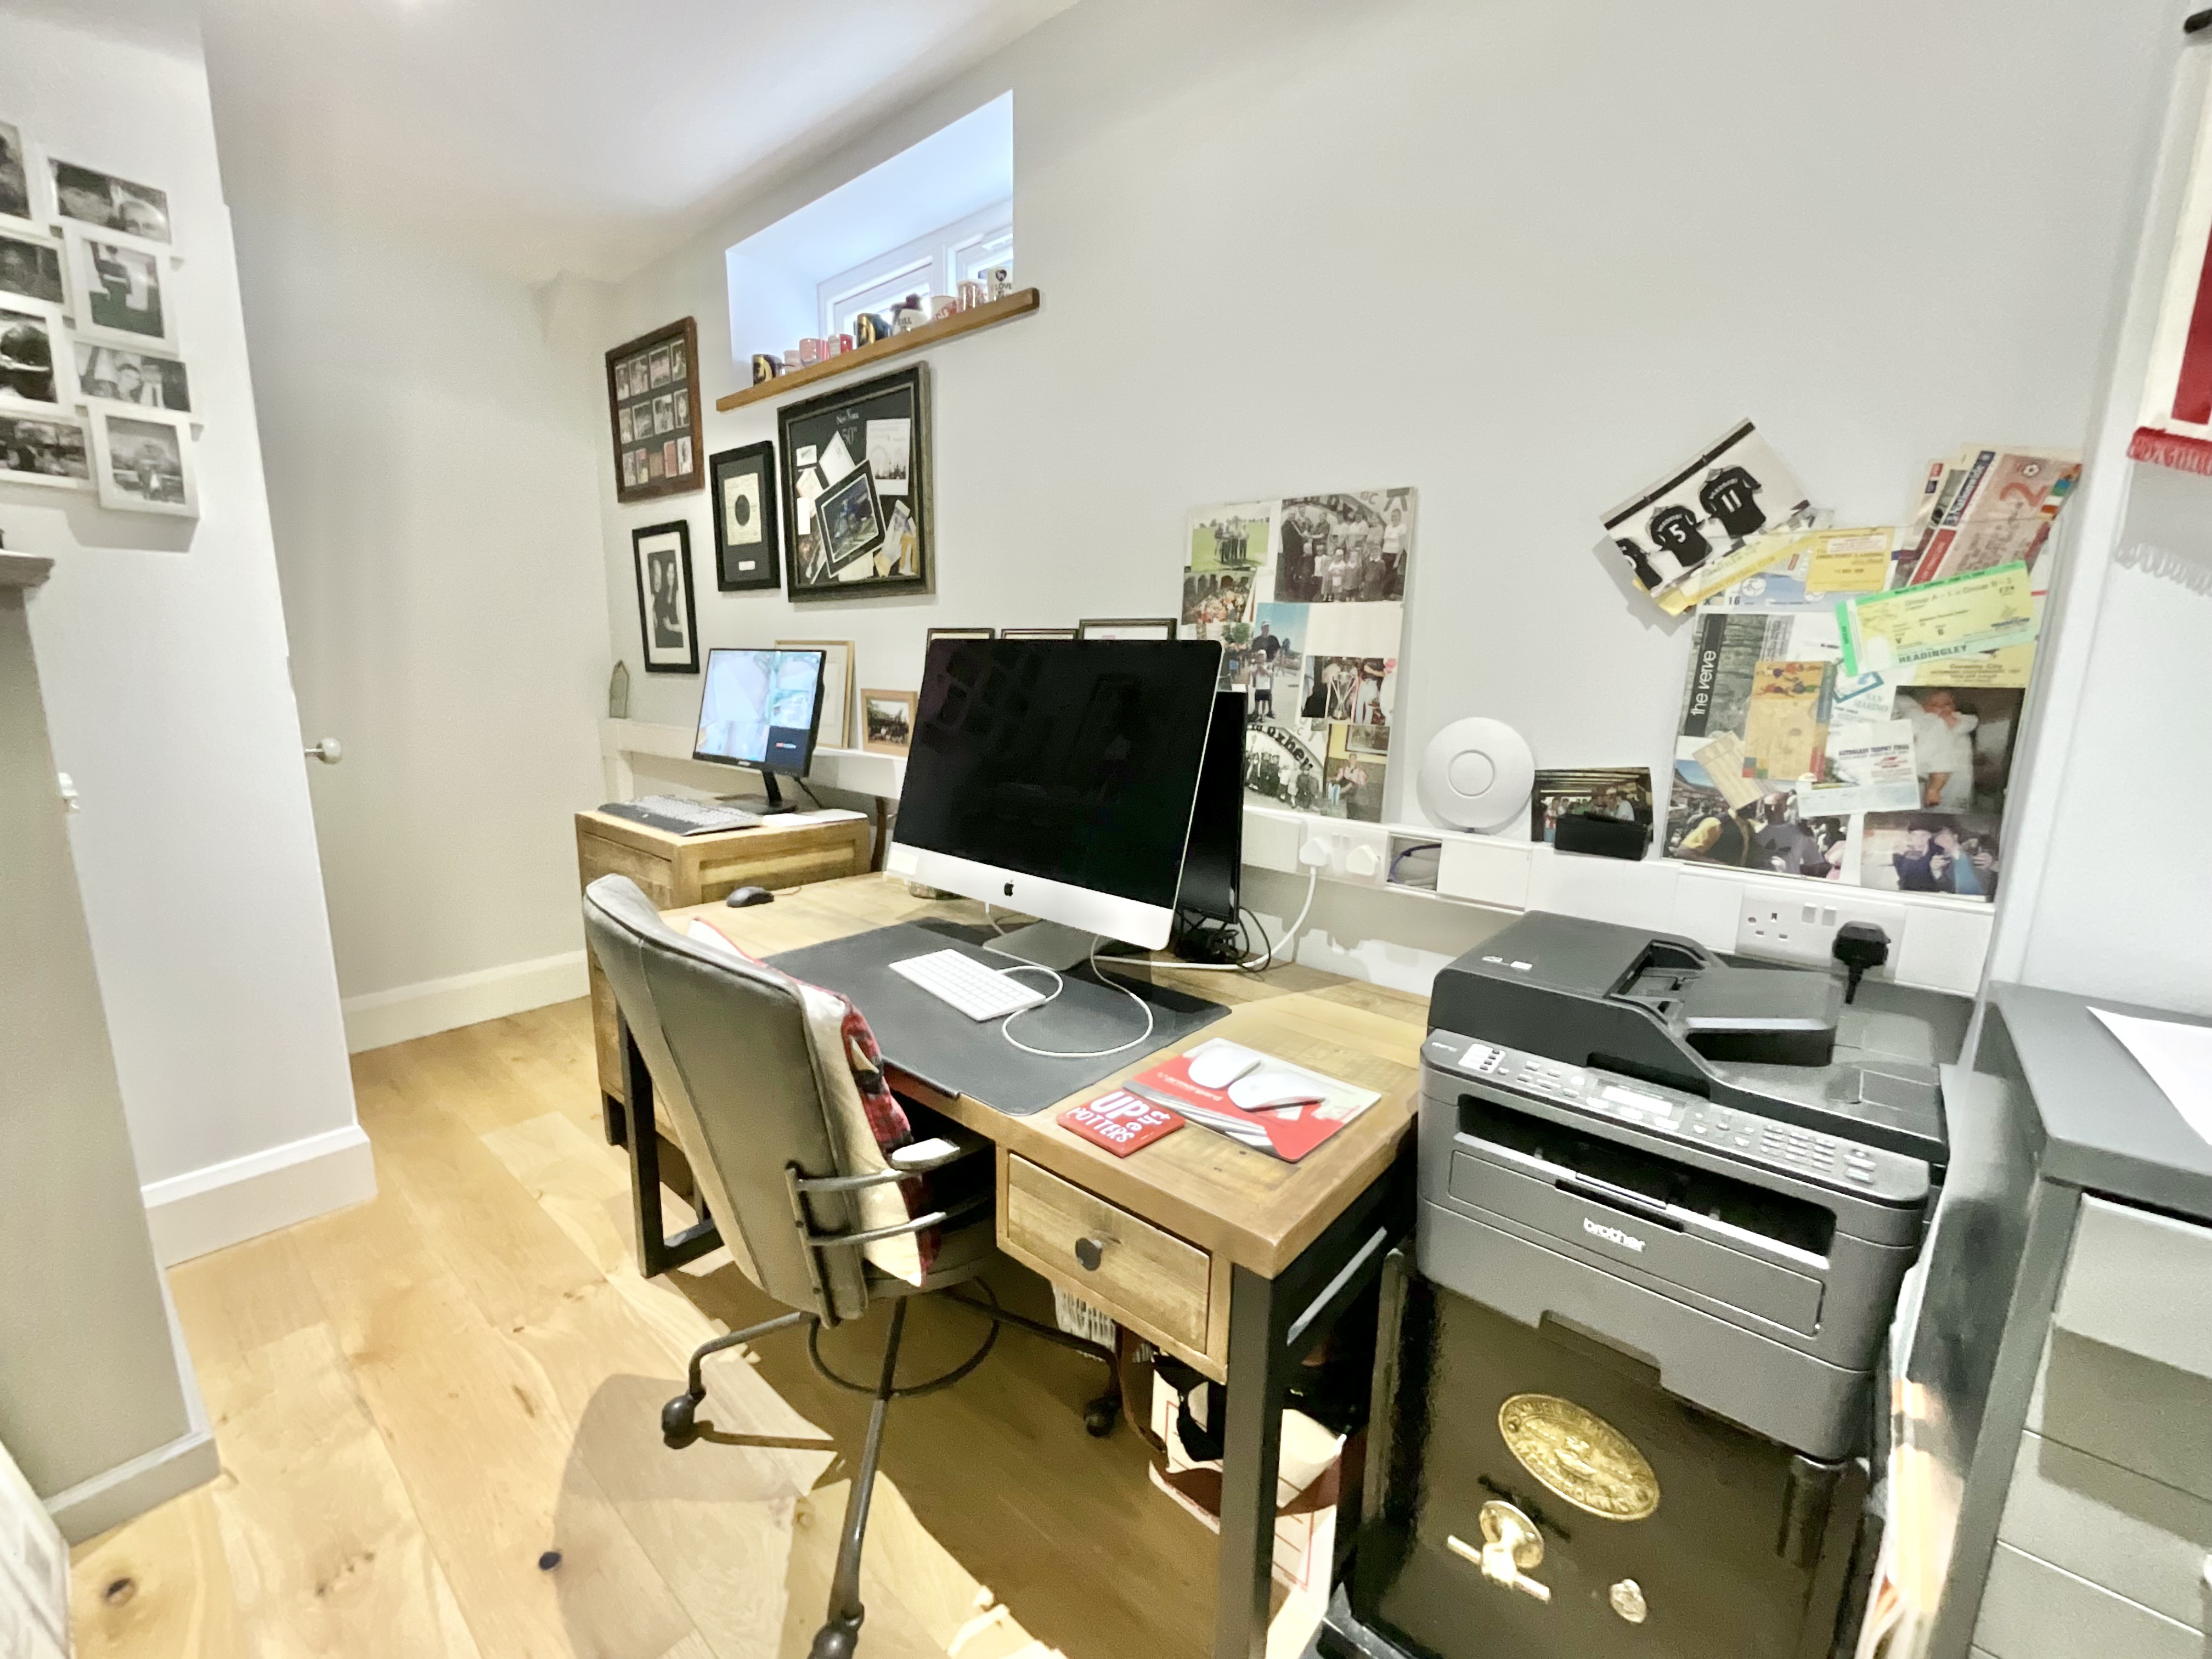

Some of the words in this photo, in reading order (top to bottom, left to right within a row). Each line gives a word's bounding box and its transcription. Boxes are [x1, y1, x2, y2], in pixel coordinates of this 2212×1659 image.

[1720, 489, 1742, 514] 11
[1668, 523, 1686, 544] 5
[1729, 596, 1740, 605] 16
[1898, 644, 1967, 664] HEADINGLEY
[1698, 650, 1717, 689] verve
[1690, 692, 1708, 716] the
[1090, 1091, 1150, 1119] UP
[1066, 1107, 1135, 1142] POTTERS
[1583, 1217, 1646, 1253] brother
